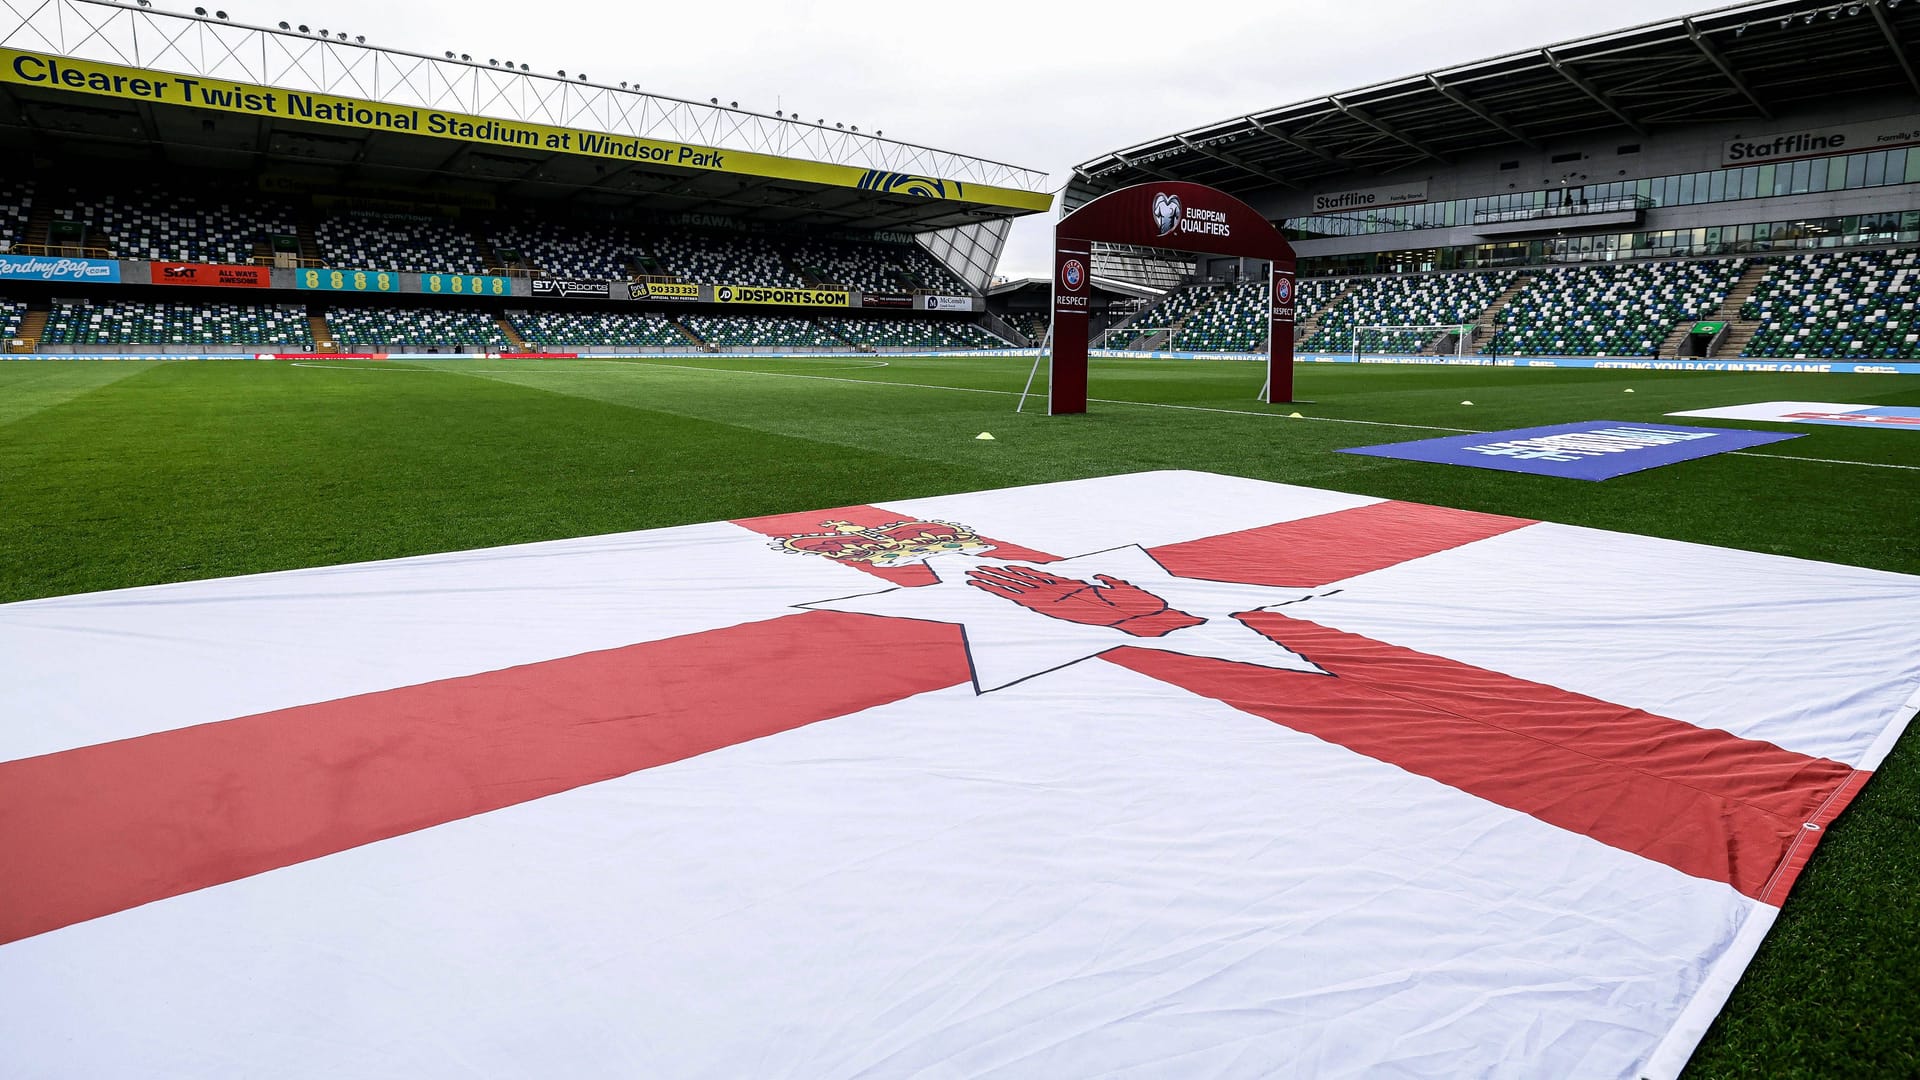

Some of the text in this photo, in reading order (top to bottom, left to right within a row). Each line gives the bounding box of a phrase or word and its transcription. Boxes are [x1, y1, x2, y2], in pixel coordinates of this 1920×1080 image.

[12, 54, 725, 169] Clearer Twist National Stadium at Windsor Park
[1729, 134, 1846, 160] Staffline
[1877, 132, 1911, 142] Family
[1316, 192, 1376, 209] Staffline
[682, 212, 733, 227] #GAWA
[1186, 207, 1226, 222] EUROPEAN
[1181, 218, 1230, 237] QUALIFIERS
[873, 231, 914, 244] #GAWA
[235, 270, 258, 278] WAYS
[219, 277, 258, 285] AWESOME
[533, 280, 609, 293] STATSports
[631, 289, 647, 298] CAB
[664, 286, 680, 294] 333
[720, 290, 731, 299] JD
[735, 289, 846, 305] JDSPORTS.COM
[1056, 295, 1088, 306] RESPECT
[1273, 307, 1294, 316] RESPECT
